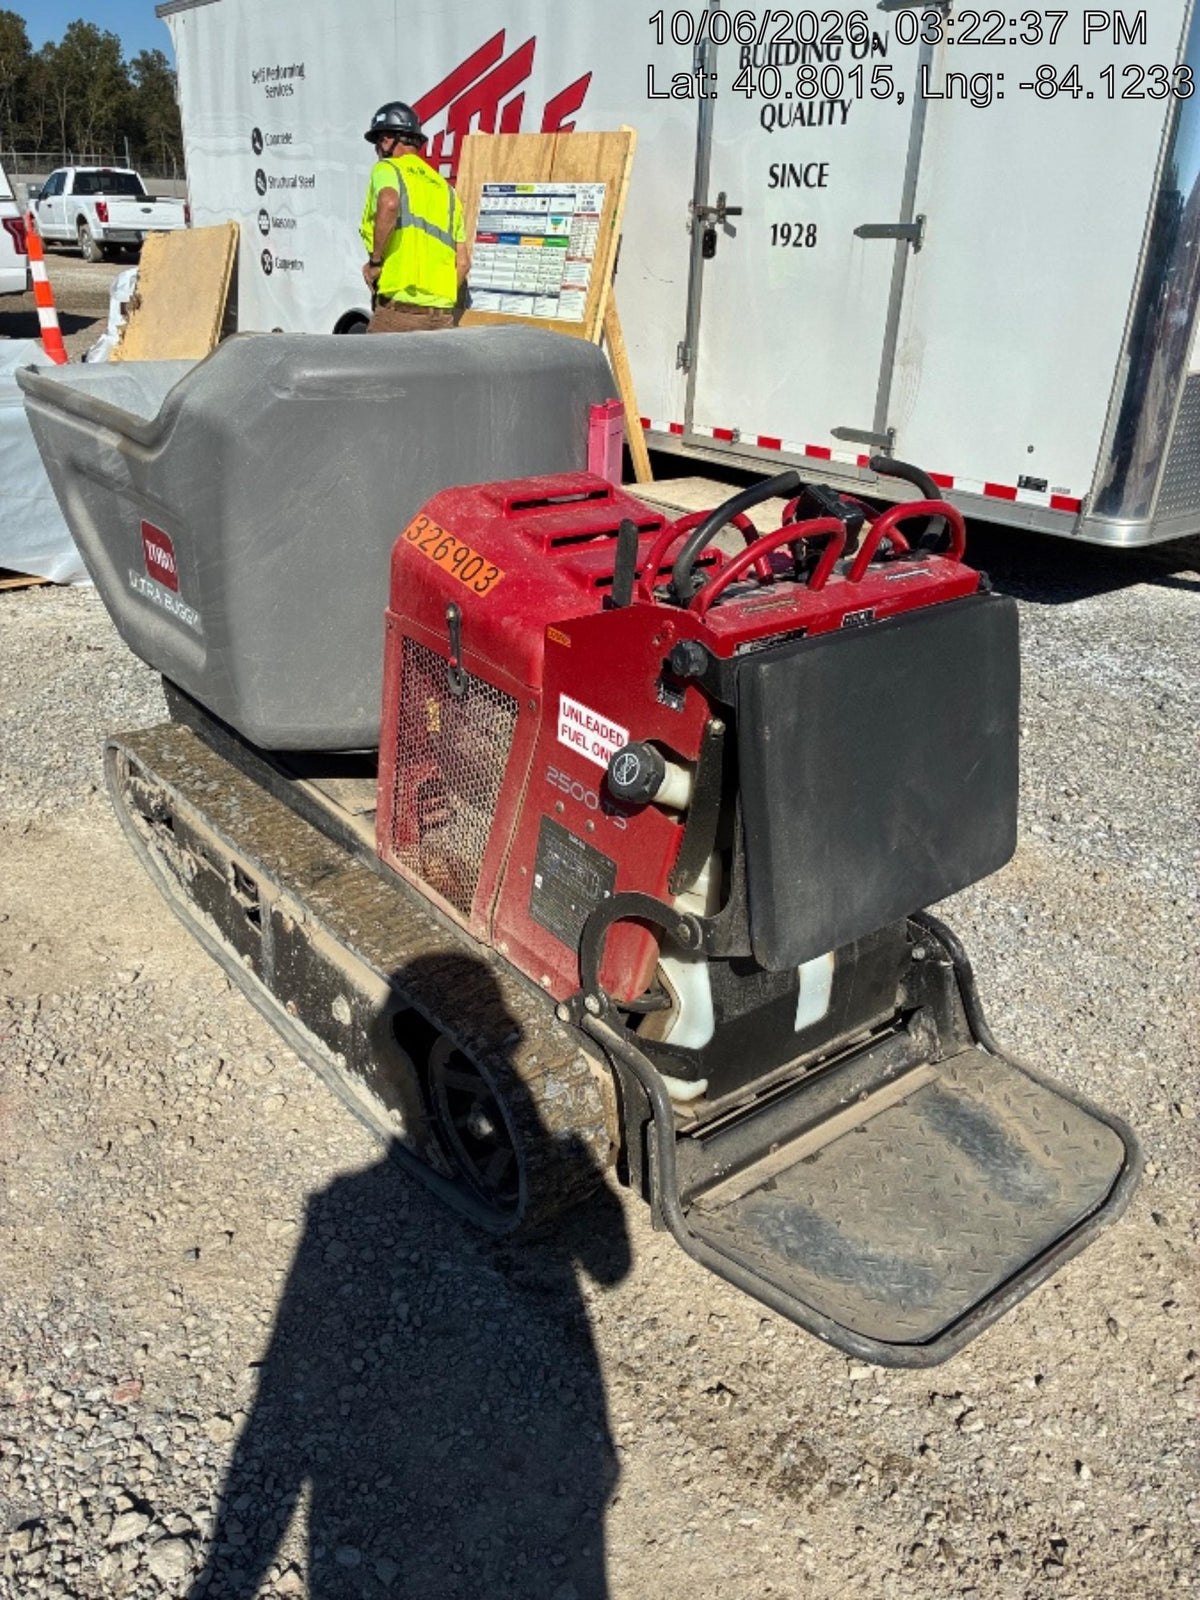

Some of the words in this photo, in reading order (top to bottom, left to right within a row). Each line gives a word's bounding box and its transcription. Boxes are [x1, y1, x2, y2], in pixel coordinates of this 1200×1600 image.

[739, 35, 842, 70] BUILDING
[851, 30, 890, 60] ON
[265, 83, 294, 99] Services
[759, 98, 853, 133] QUALITY
[265, 132, 292, 147] Concrete
[268, 175, 297, 190] Structural
[298, 173, 315, 189] Steel
[768, 162, 830, 189] SINCE
[769, 222, 818, 249] 1928
[274, 256, 304, 273] Carpentry
[144, 539, 176, 574] TORO
[406, 516, 500, 593] 326903
[562, 701, 625, 748] UNLEADED
[560, 723, 589, 751] FUEL
[592, 741, 613, 763] ON
[547, 765, 600, 810] 2500
